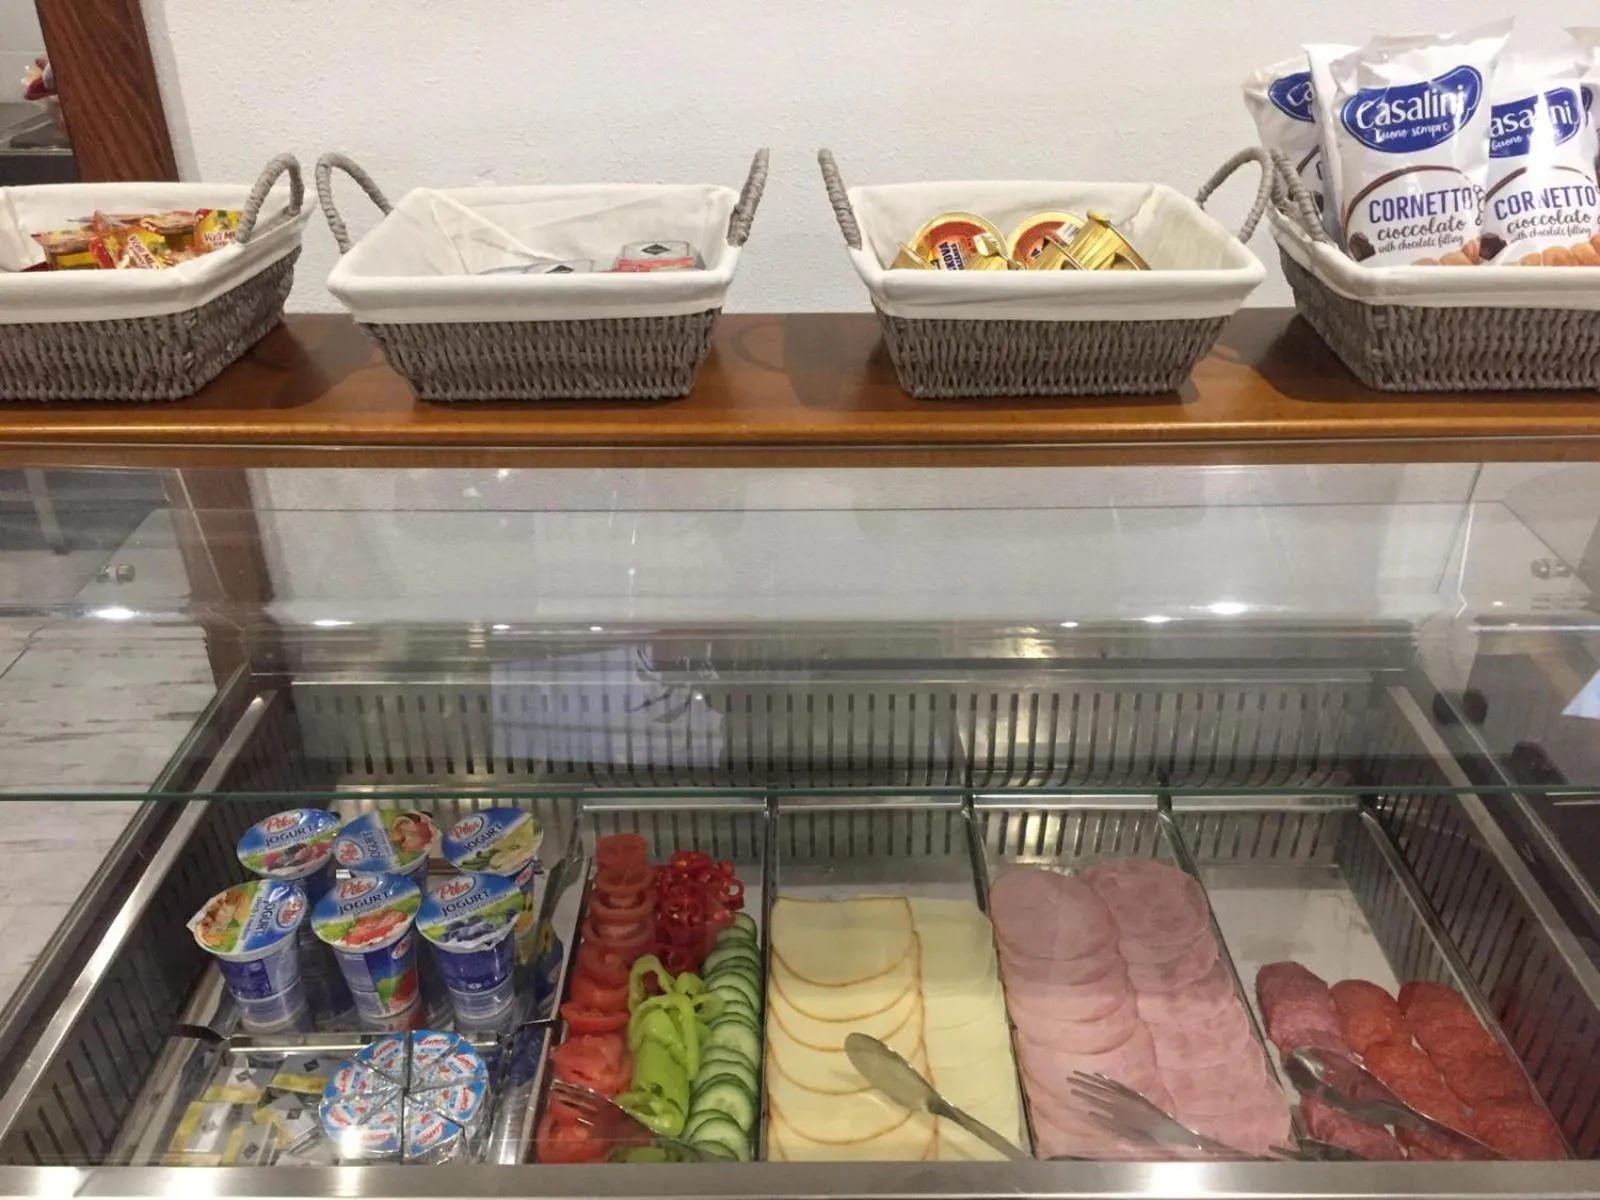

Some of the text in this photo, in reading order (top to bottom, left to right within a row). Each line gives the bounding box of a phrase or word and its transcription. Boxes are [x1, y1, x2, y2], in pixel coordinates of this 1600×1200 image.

[1356, 84, 1466, 130] Casalini
[1490, 100, 1574, 139] asani
[1411, 122, 1449, 139] sempre
[1368, 186, 1473, 224] CORNETTO
[1377, 215, 1466, 241] cioccolato
[1506, 209, 1592, 234] cioccolato
[1398, 236, 1435, 252] chocolate
[265, 823, 315, 848] JOGURT
[465, 822, 504, 852] JOGURT
[340, 890, 390, 915] JOGURT
[441, 889, 491, 917] JOGURT
